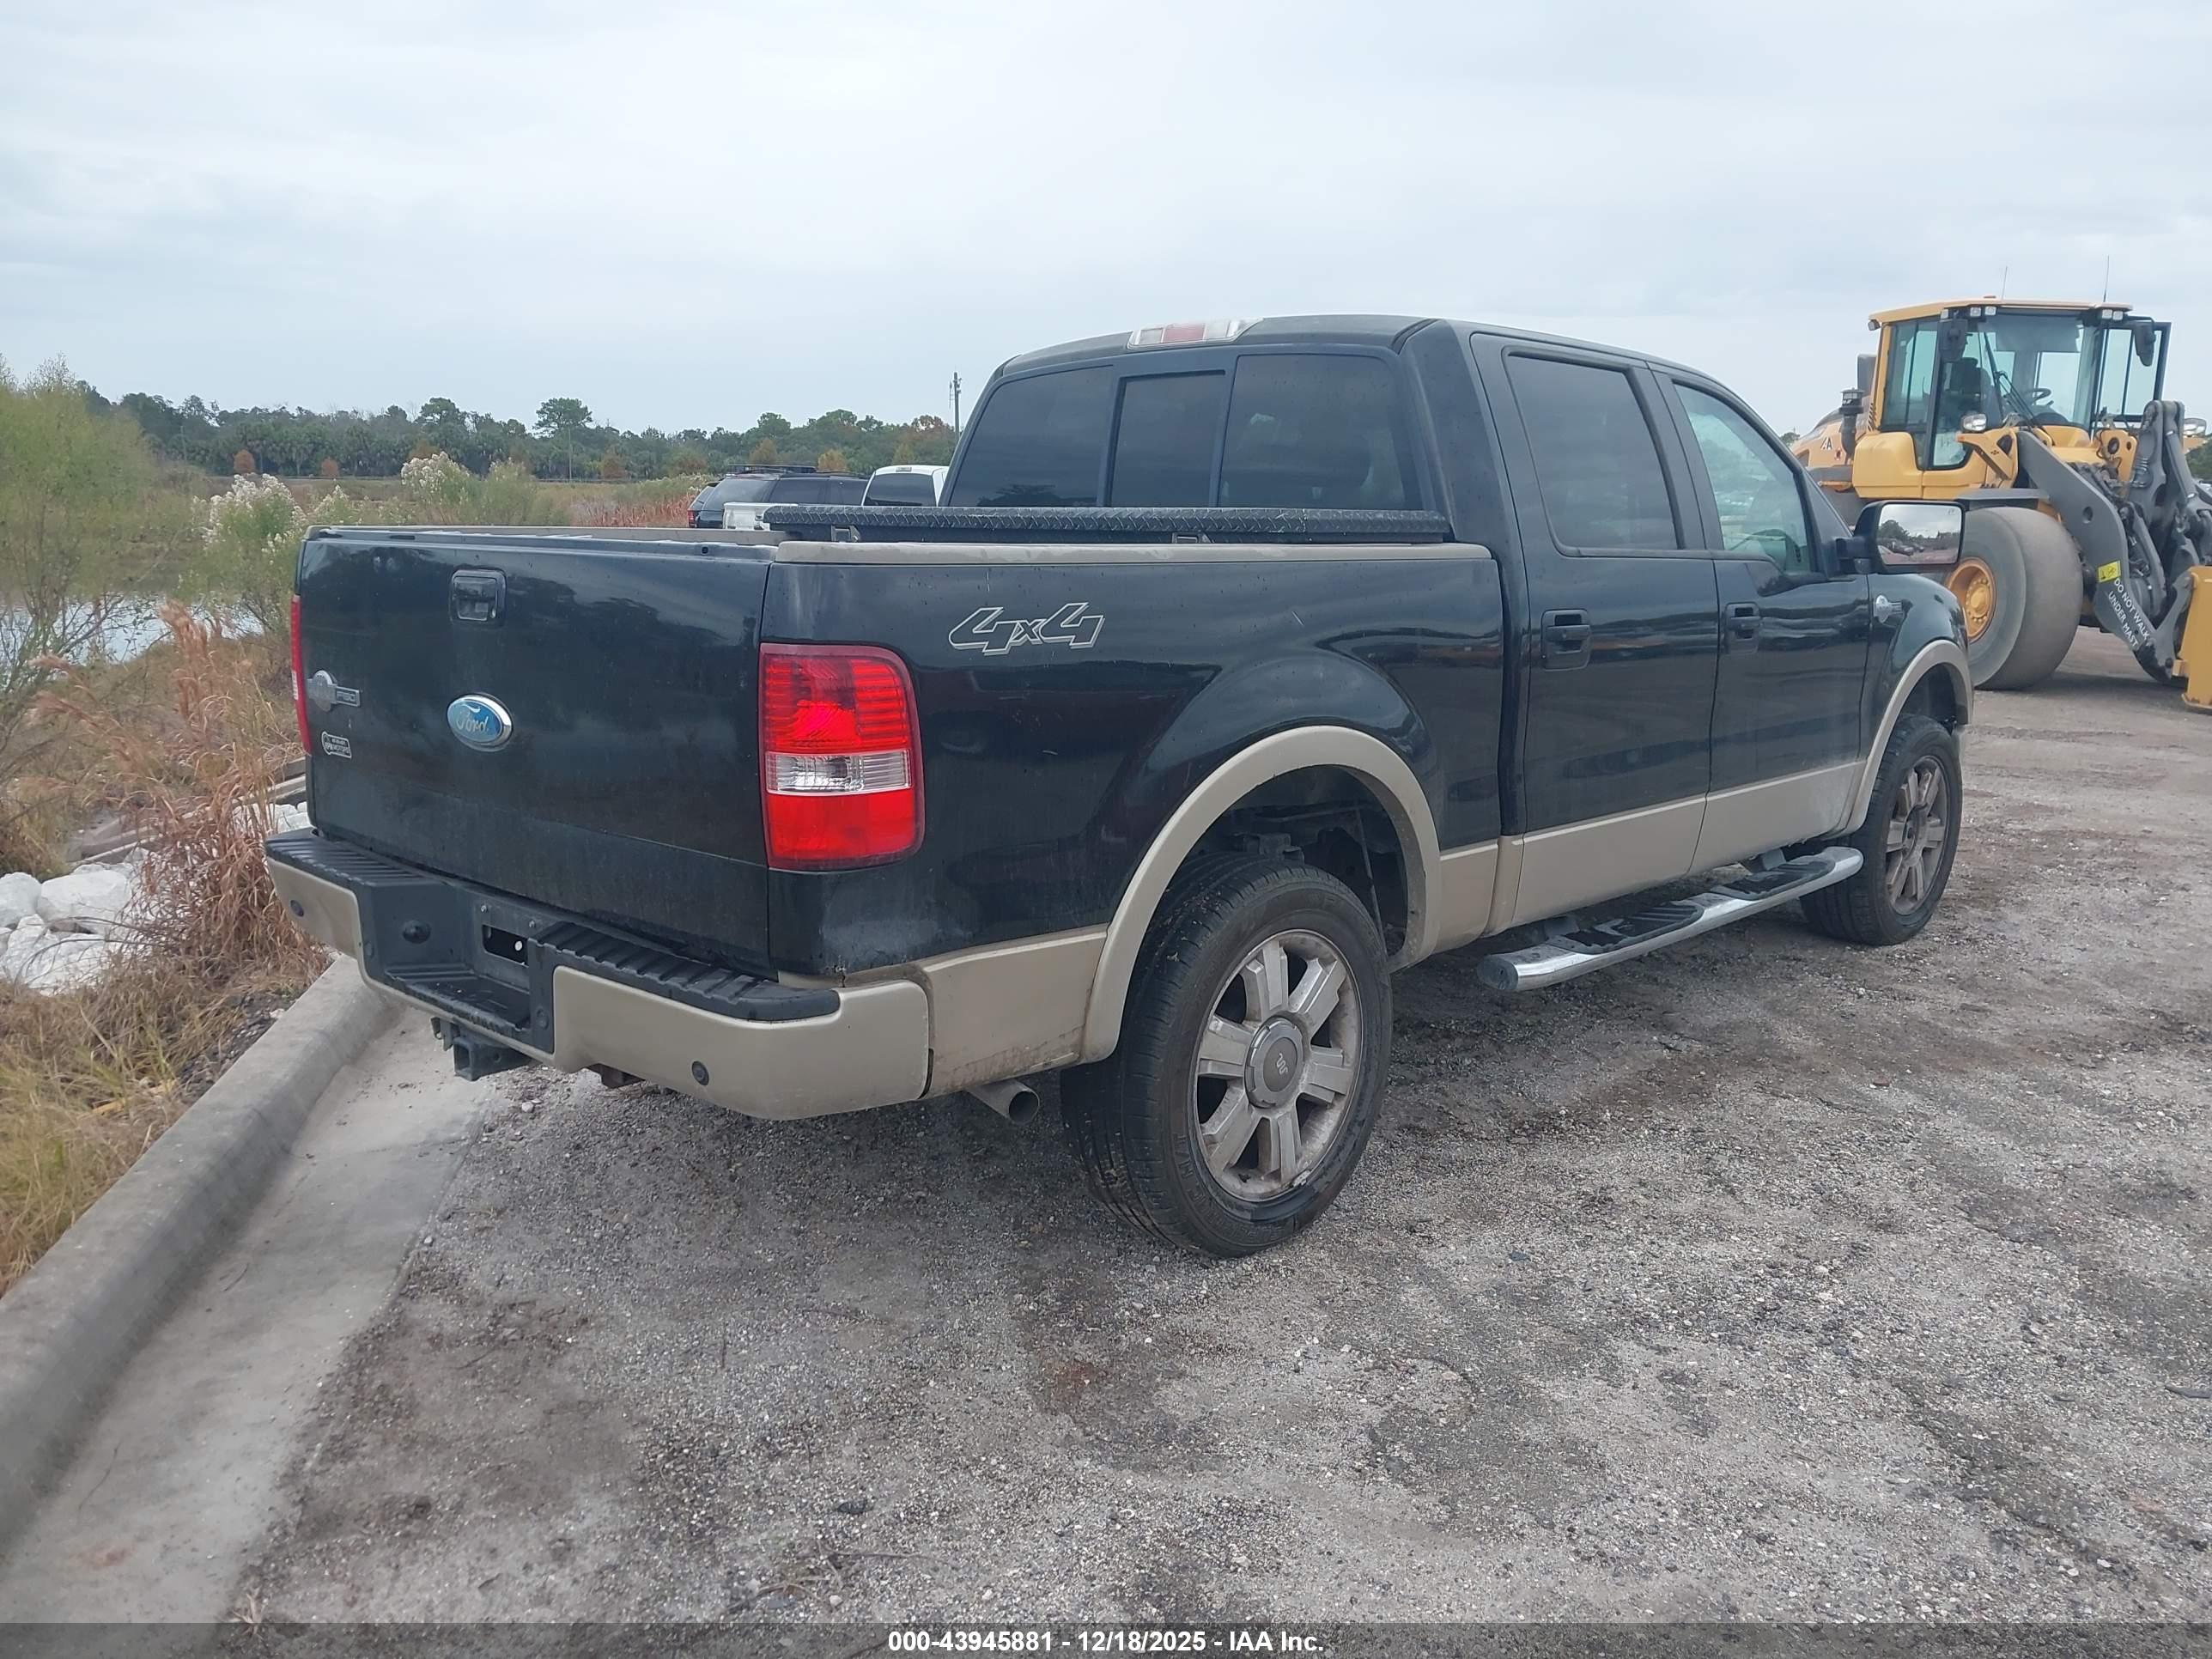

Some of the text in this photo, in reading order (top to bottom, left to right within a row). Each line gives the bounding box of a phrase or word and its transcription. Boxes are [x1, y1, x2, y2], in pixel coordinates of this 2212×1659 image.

[949, 602, 1105, 655] 4x4
[2108, 591, 2139, 647] UNDER MAST
[2114, 578, 2150, 641] DO NOT WALK
[455, 703, 489, 734] Ford
